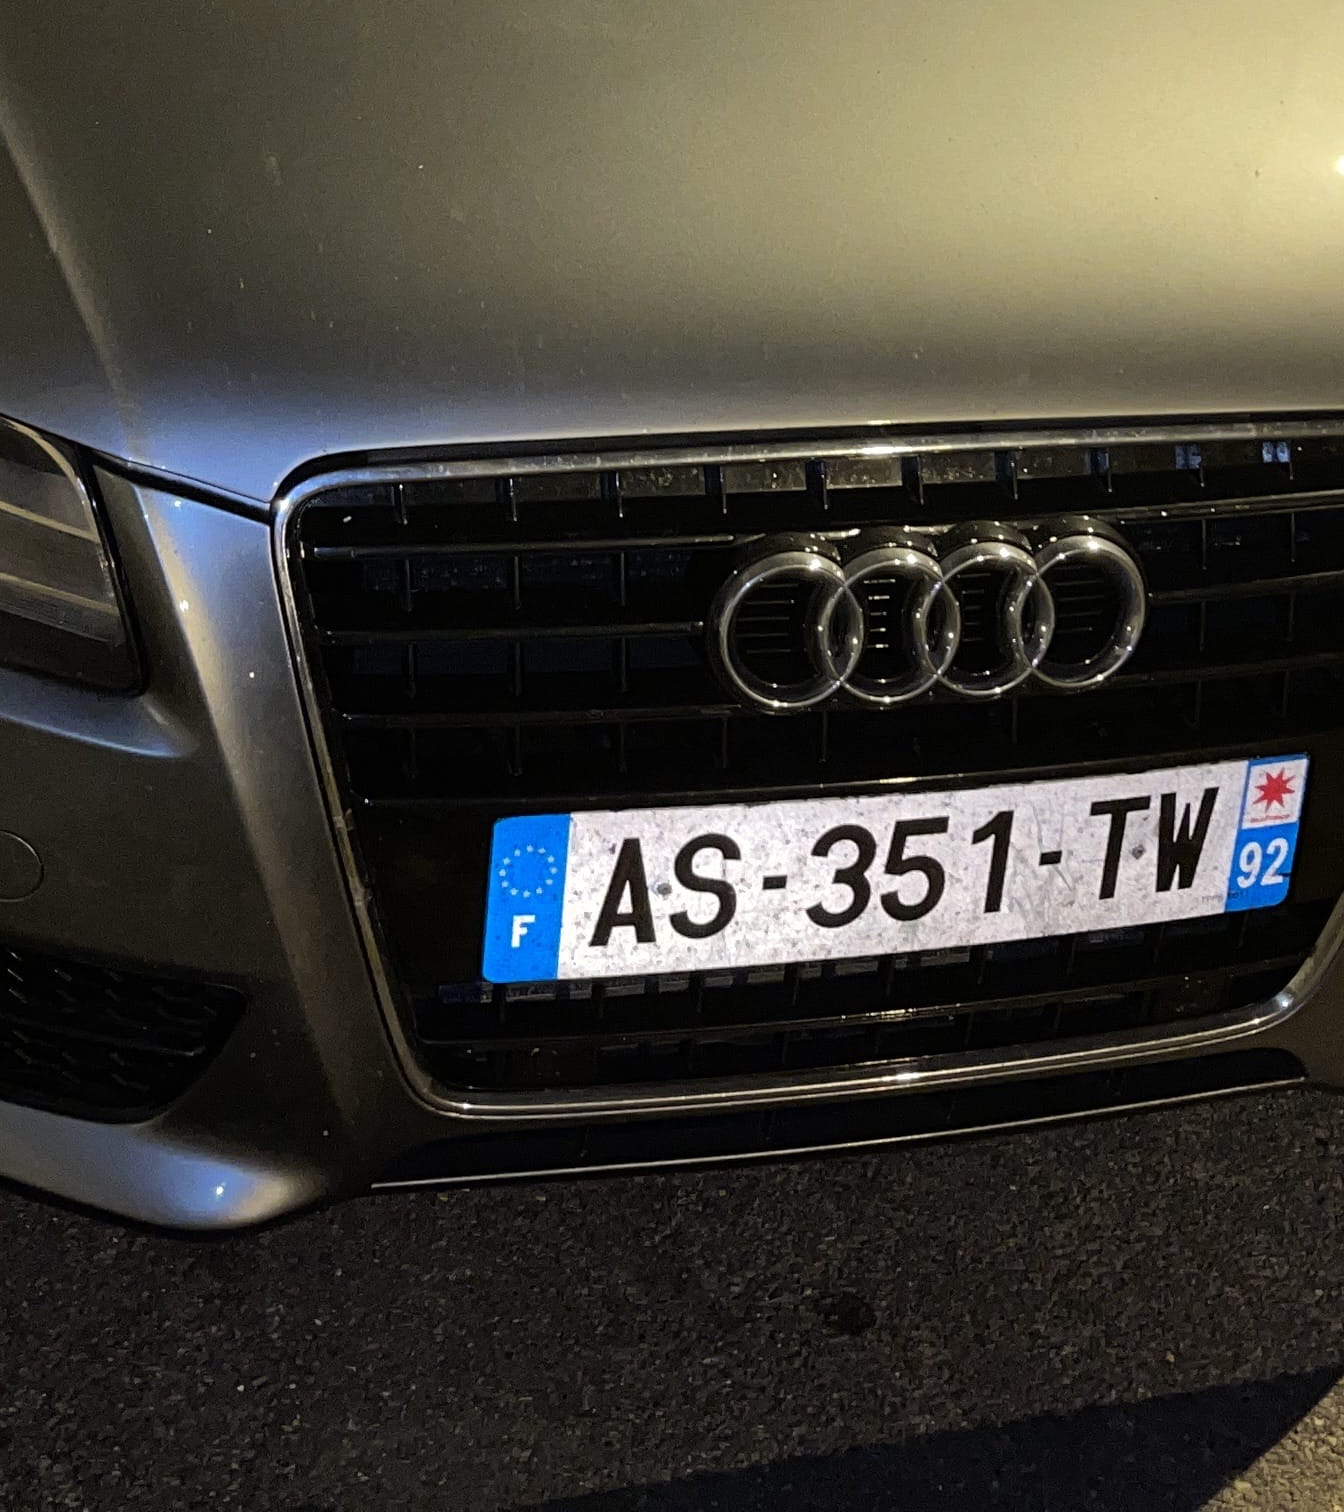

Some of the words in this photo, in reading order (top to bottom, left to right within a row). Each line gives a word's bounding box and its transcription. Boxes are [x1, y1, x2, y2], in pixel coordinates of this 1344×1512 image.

[588, 786, 1220, 947] AS-351-TW
[1236, 837, 1289, 889] 92
[511, 914, 536, 948] F
